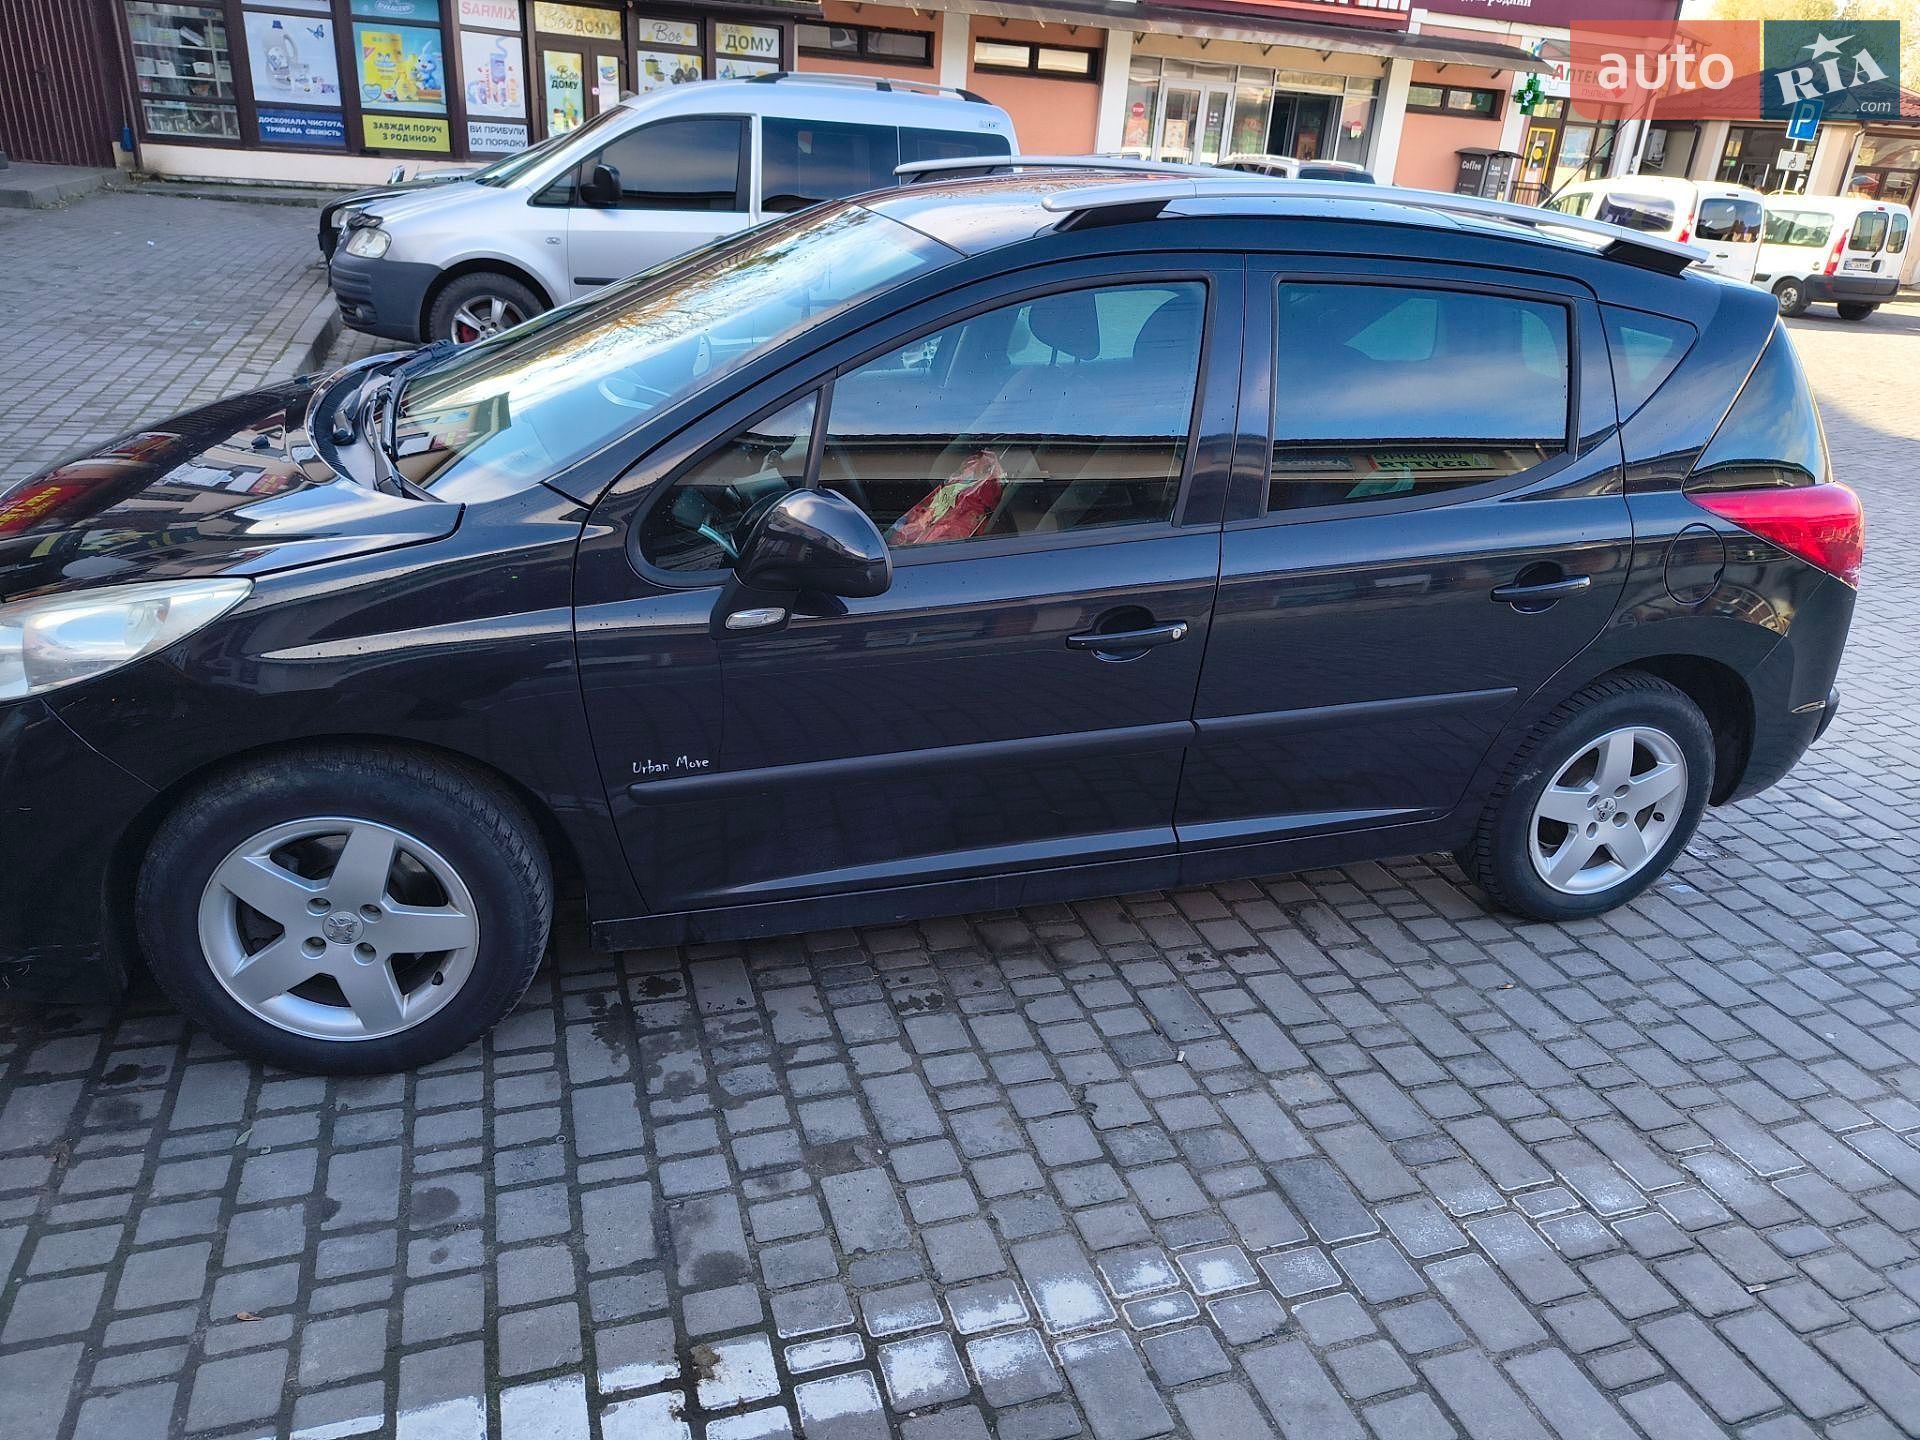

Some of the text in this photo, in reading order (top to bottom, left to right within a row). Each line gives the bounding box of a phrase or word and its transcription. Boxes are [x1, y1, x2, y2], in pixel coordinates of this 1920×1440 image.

[461, 1, 517, 20] SARMIX
[725, 33, 775, 52] ДОМУ
[551, 79, 579, 90] ДОМУ
[258, 116, 307, 126] ДОСКОНАЛА
[1794, 103, 1816, 135] P
[266, 126, 303, 135] ТРИВАЛА
[372, 121, 443, 133] ЗАВЖДИ ПОРУЧ
[469, 125, 526, 136] ВИ ПРИБУЛИ
[382, 132, 437, 144] З РОДИНОЮ
[470, 137, 527, 148] ДО ПОРЯДКУ
[1461, 160, 1482, 171] Coffee
[632, 755, 710, 774] Urban Move
